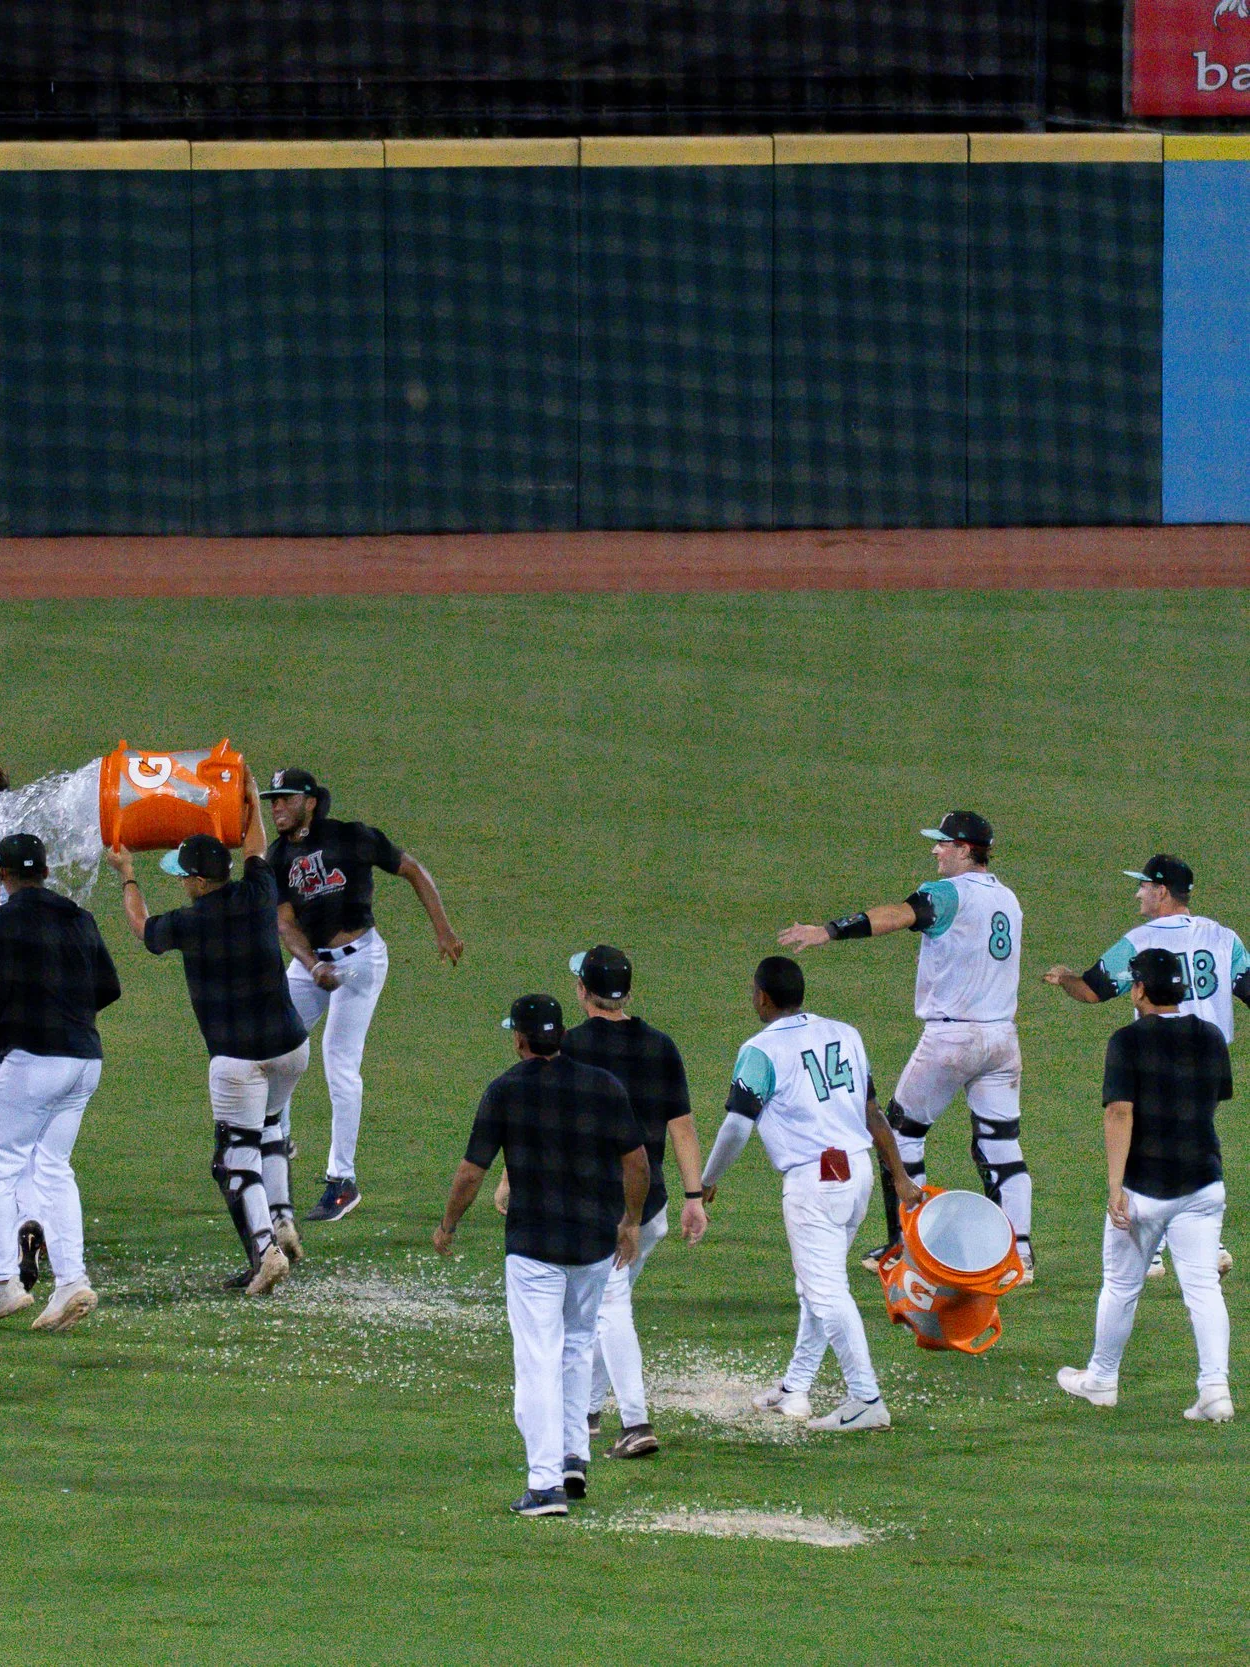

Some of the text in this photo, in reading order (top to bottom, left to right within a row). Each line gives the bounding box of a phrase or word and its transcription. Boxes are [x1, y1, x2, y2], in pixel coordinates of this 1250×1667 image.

[128, 756, 172, 789] G
[988, 911, 1012, 961] 8
[800, 1041, 855, 1103] 14
[903, 1270, 938, 1311] G
